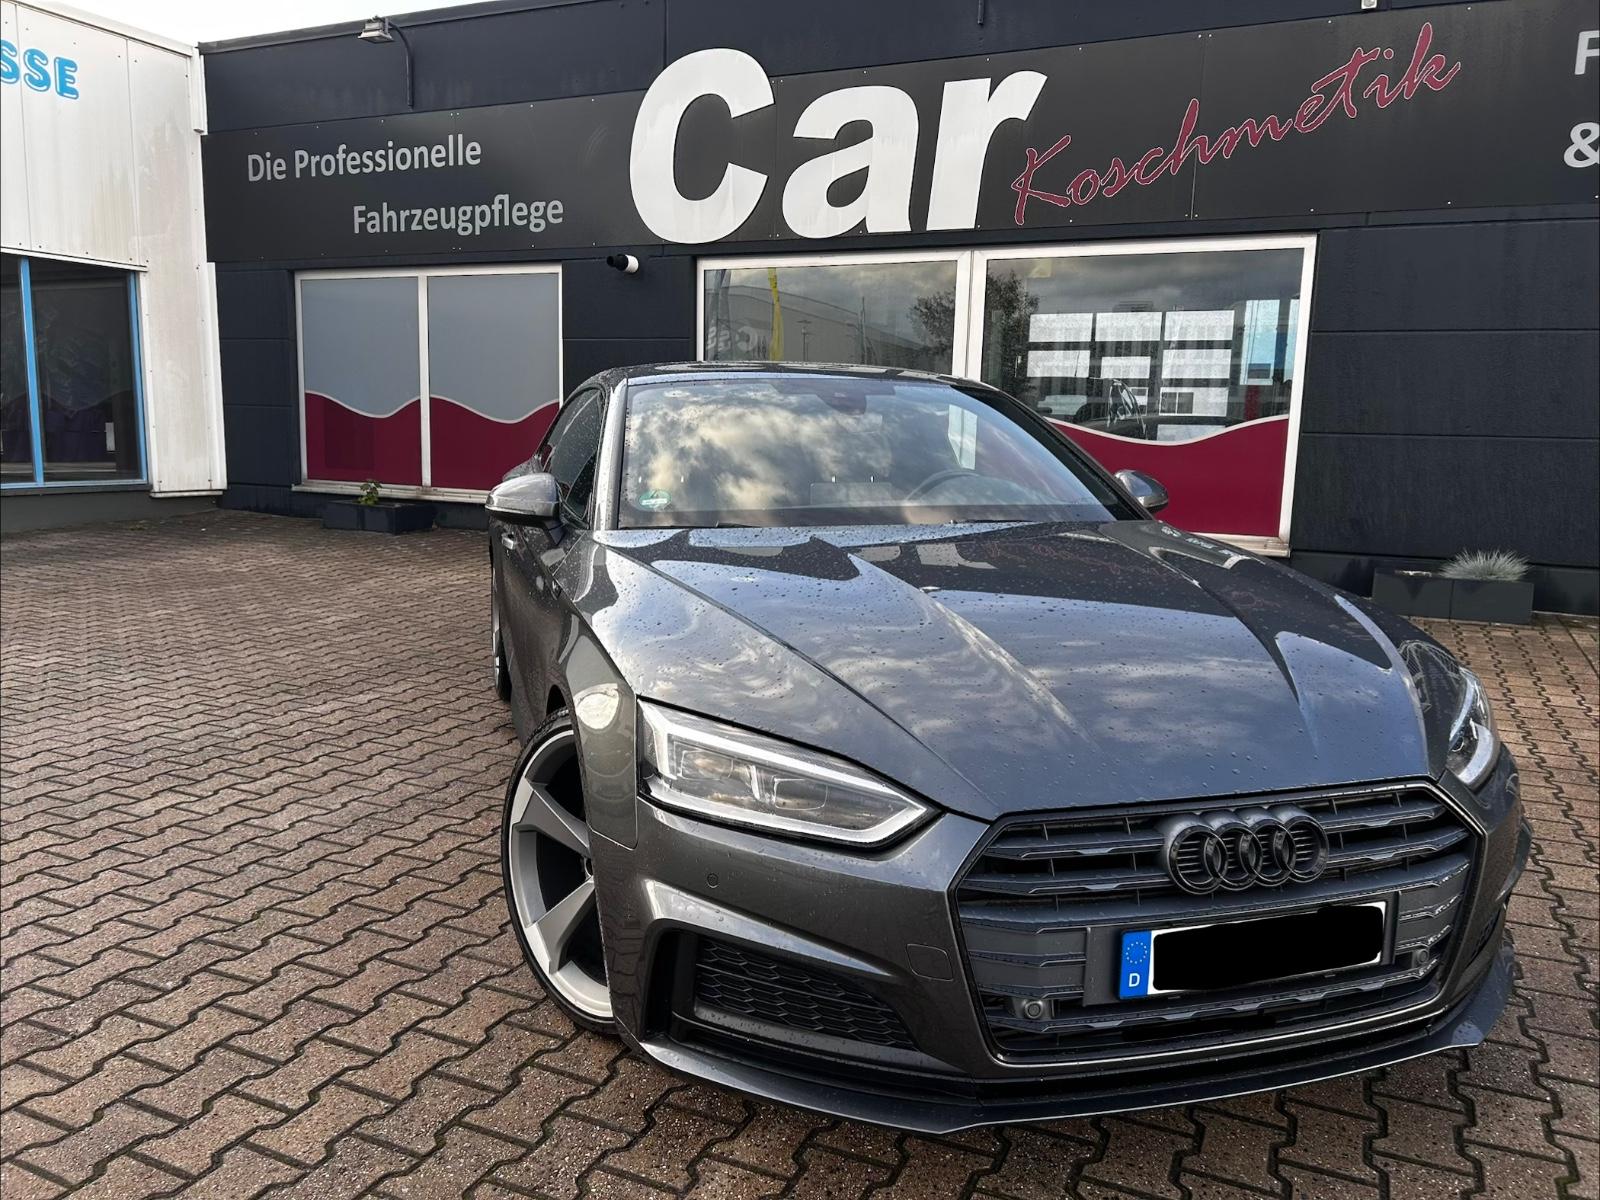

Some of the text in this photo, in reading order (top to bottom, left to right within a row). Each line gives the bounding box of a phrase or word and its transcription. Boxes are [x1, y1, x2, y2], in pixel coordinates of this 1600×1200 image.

[0, 39, 80, 100] SSE
[247, 133, 482, 182] Die Professionelle
[629, 22, 1462, 244] Car Koschmetik
[353, 193, 564, 236] Fahrzeugpflege
[1128, 972, 1141, 988] D
